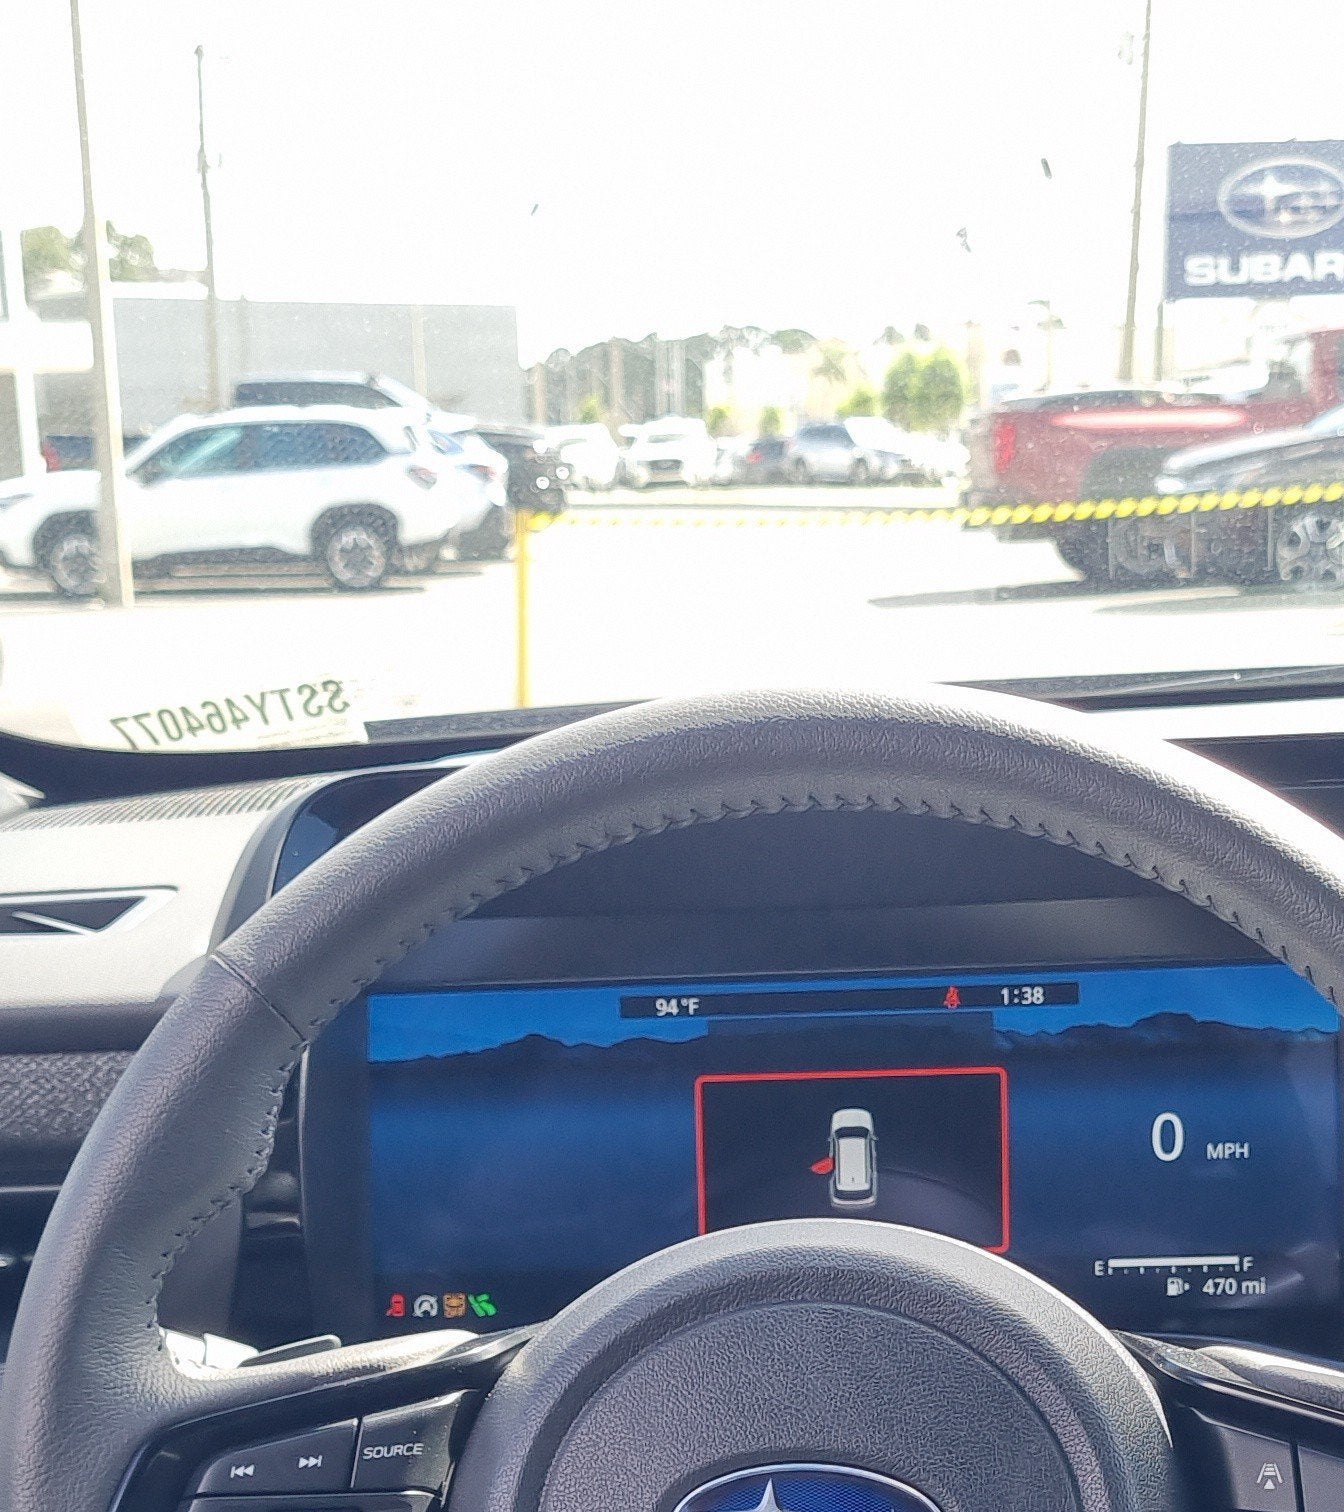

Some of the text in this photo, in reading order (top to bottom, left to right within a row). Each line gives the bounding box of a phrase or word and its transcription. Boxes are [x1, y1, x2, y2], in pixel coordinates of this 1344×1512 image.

[655, 986, 1045, 1017] 94°F 1:38
[1151, 1111, 1250, 1162] 0 MPH
[1094, 1256, 1254, 1276] E F
[1202, 1277, 1267, 1296] 470 mi
[363, 1442, 424, 1460] SOURCE
